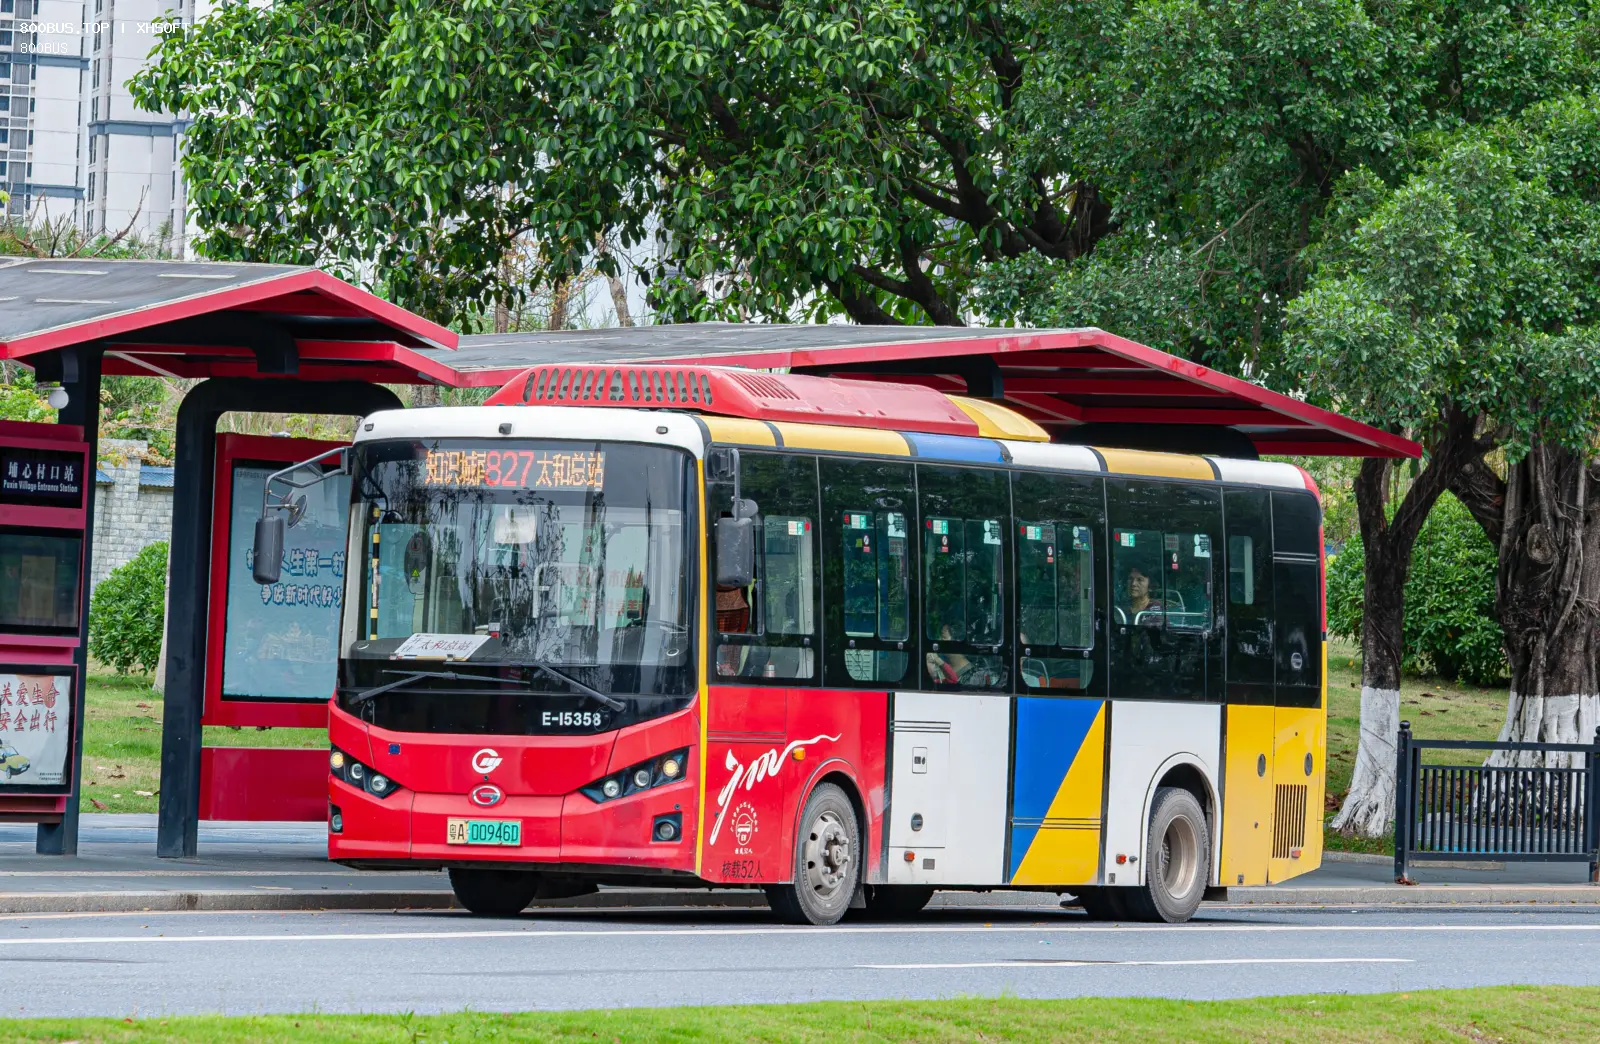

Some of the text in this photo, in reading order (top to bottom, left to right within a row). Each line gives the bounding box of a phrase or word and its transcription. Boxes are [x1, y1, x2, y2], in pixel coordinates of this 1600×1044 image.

[8, 461, 74, 481] 埔心村口站
[485, 450, 535, 487] 827
[535, 451, 604, 488] 太和总站
[3, 479, 78, 493] Puxin Village Entrance Station
[0, 708, 58, 733] 安全出行
[721, 860, 764, 879] 核载52人
